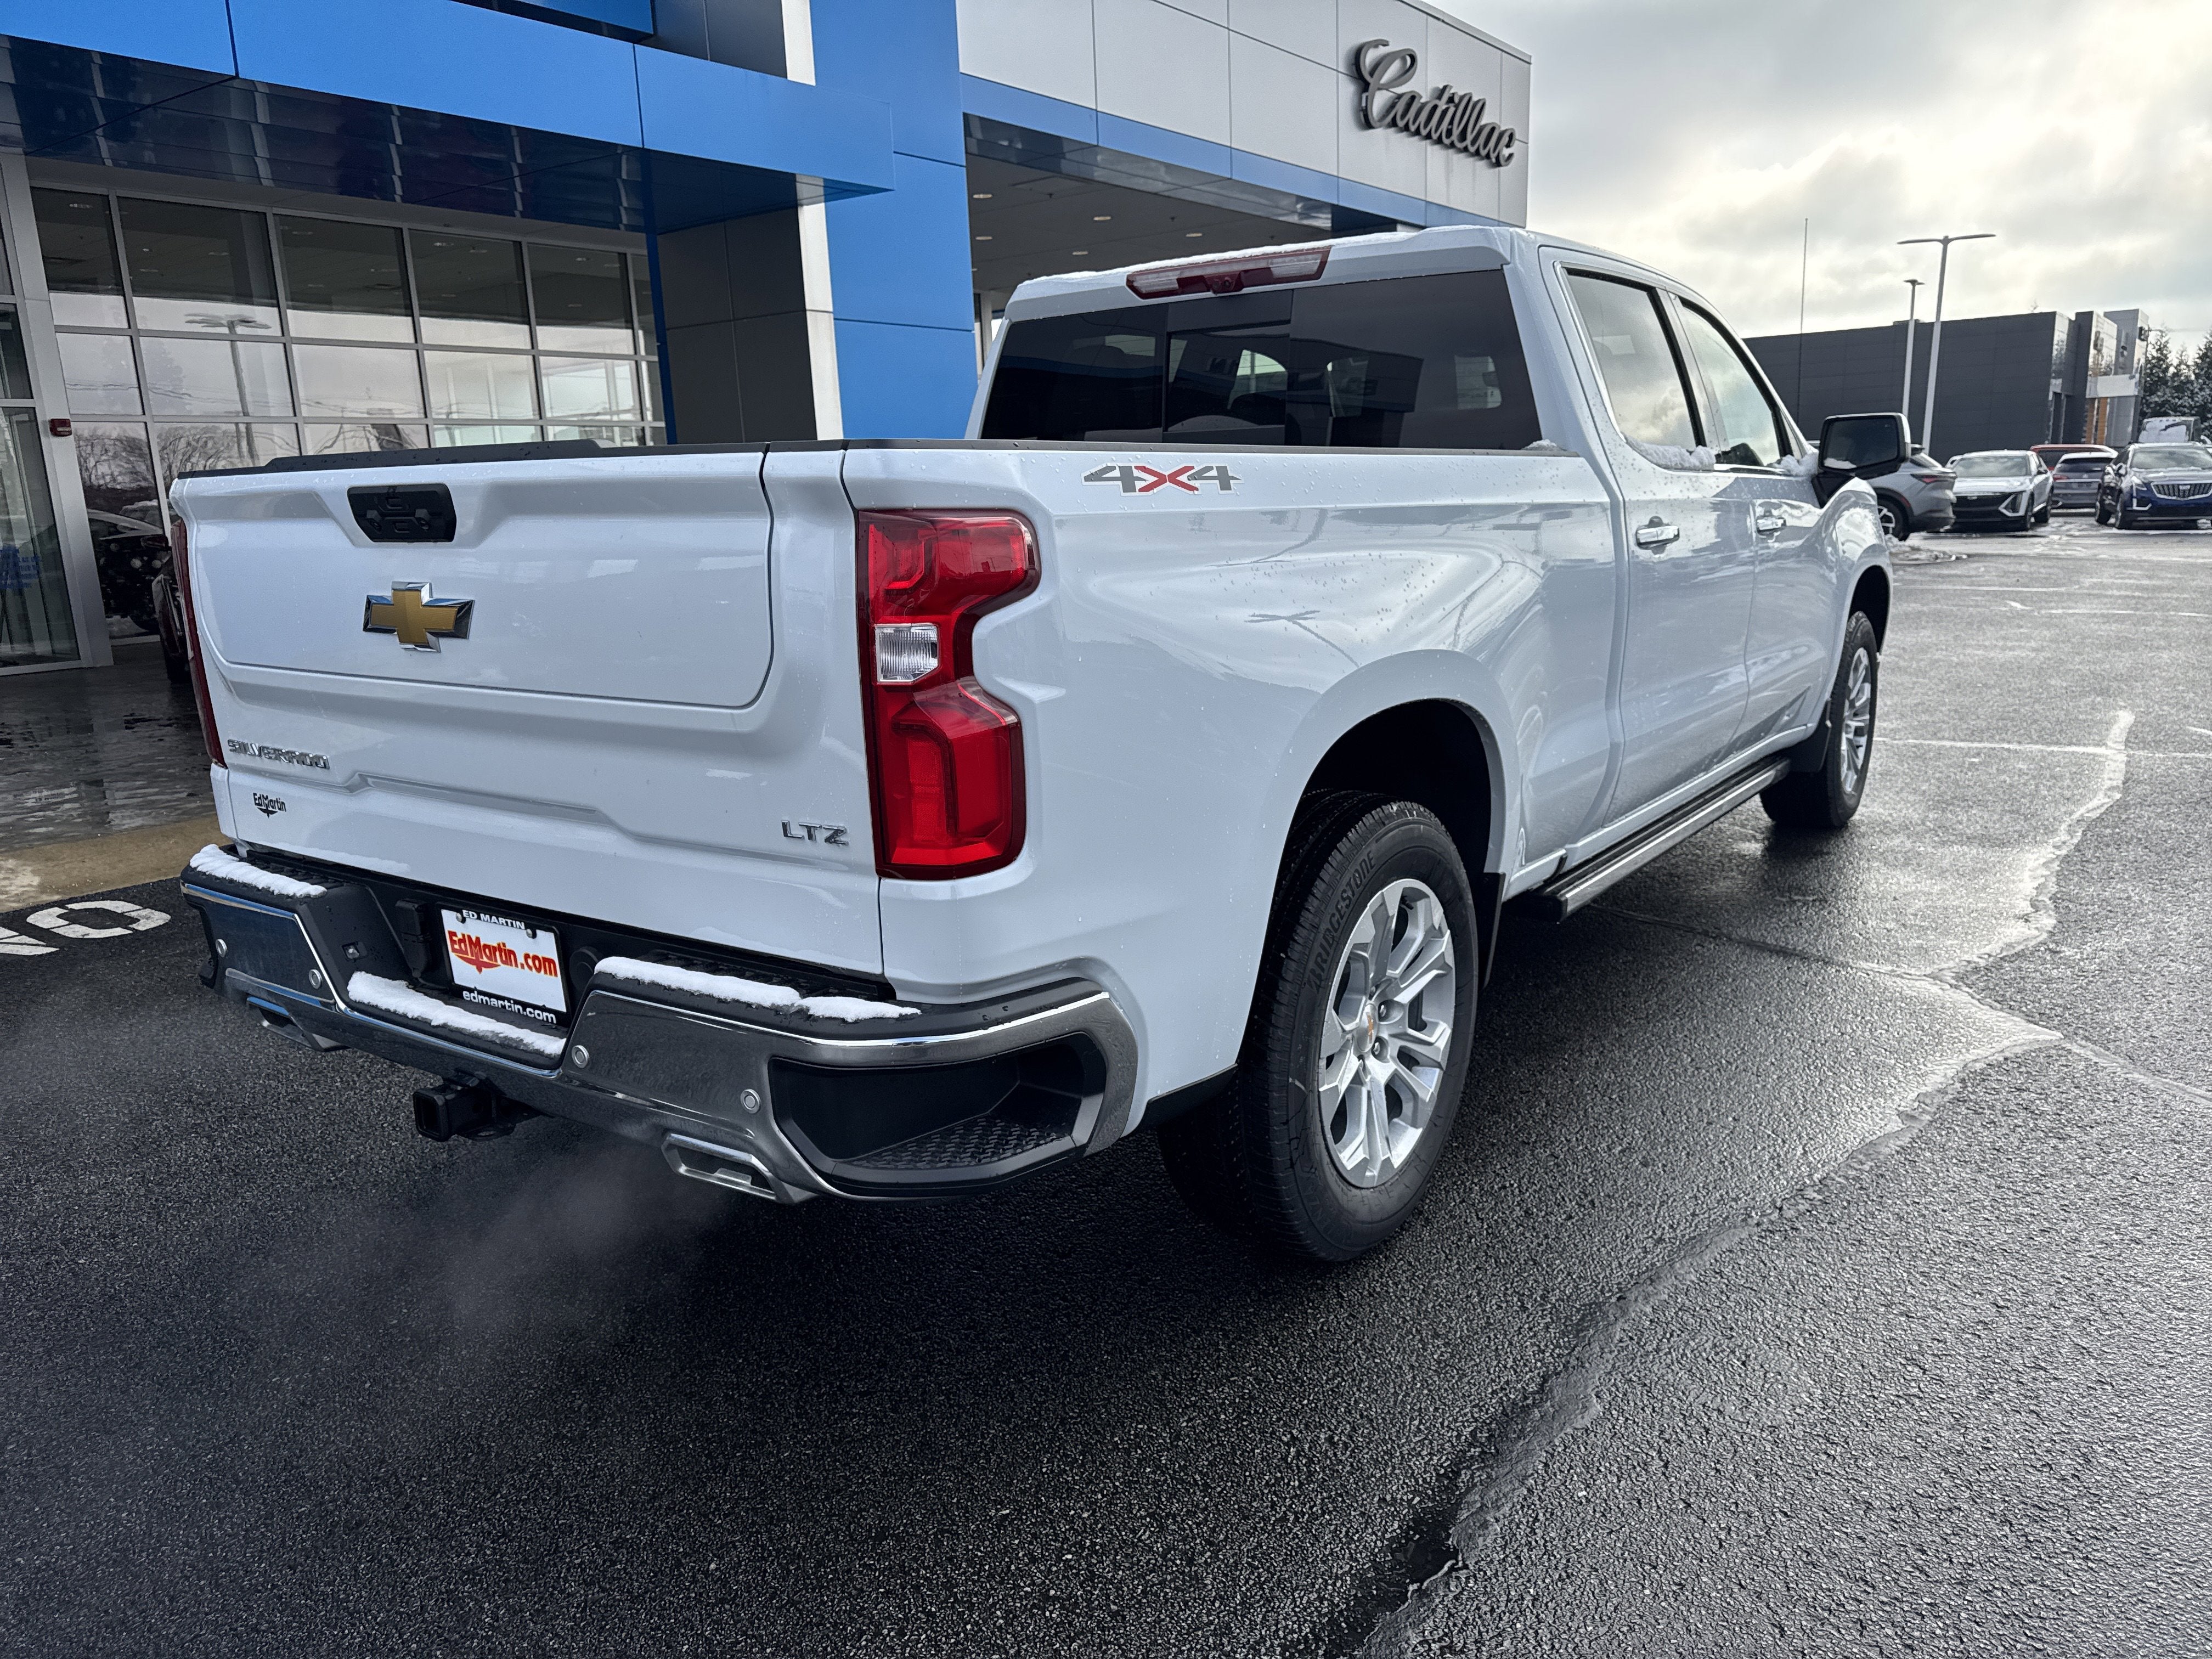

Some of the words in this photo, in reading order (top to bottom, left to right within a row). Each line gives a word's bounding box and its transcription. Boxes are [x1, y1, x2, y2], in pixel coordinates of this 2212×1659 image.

[1355, 38, 1516, 167] Cadillac
[227, 739, 330, 770] SILVERADO
[252, 792, 286, 812] EdMartin
[781, 820, 849, 846] LTZ
[462, 909, 478, 919] ED
[480, 913, 526, 930] MARTIN
[1307, 850, 1376, 994] BRIDGESTONE
[462, 990, 557, 1024] edmartin.com
